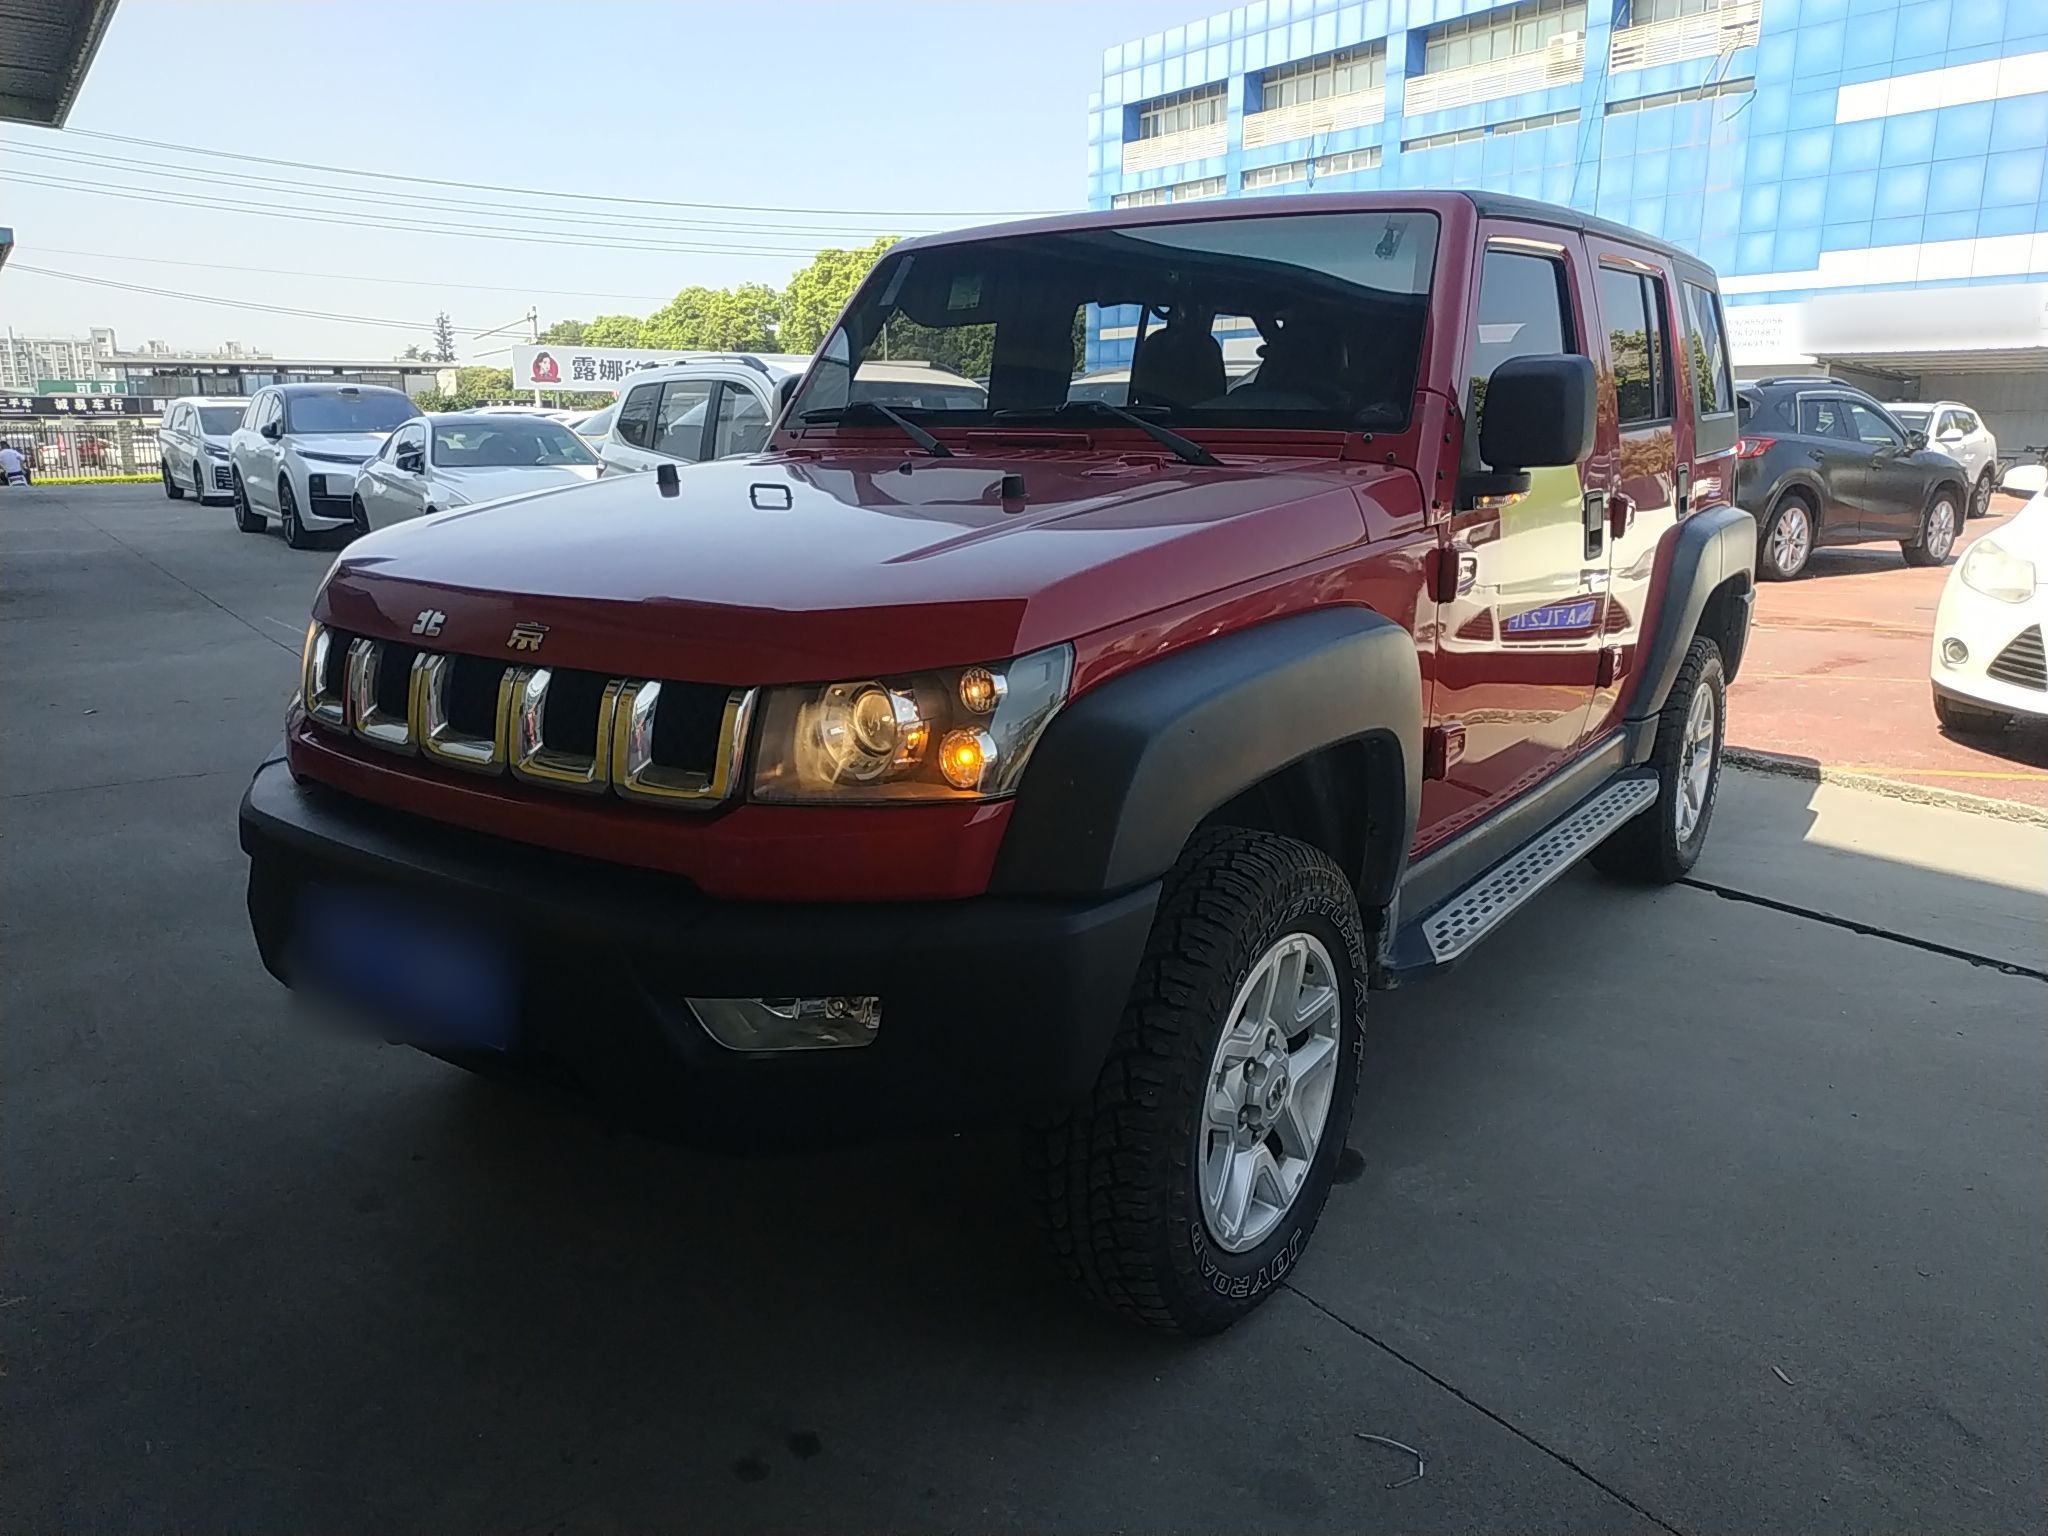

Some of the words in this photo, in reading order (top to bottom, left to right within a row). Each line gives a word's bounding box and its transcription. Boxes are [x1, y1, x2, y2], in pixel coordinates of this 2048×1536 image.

[75, 382, 128, 394] 可可
[411, 609, 551, 652] 北京
[1191, 1222, 1302, 1298] JOYROAD
